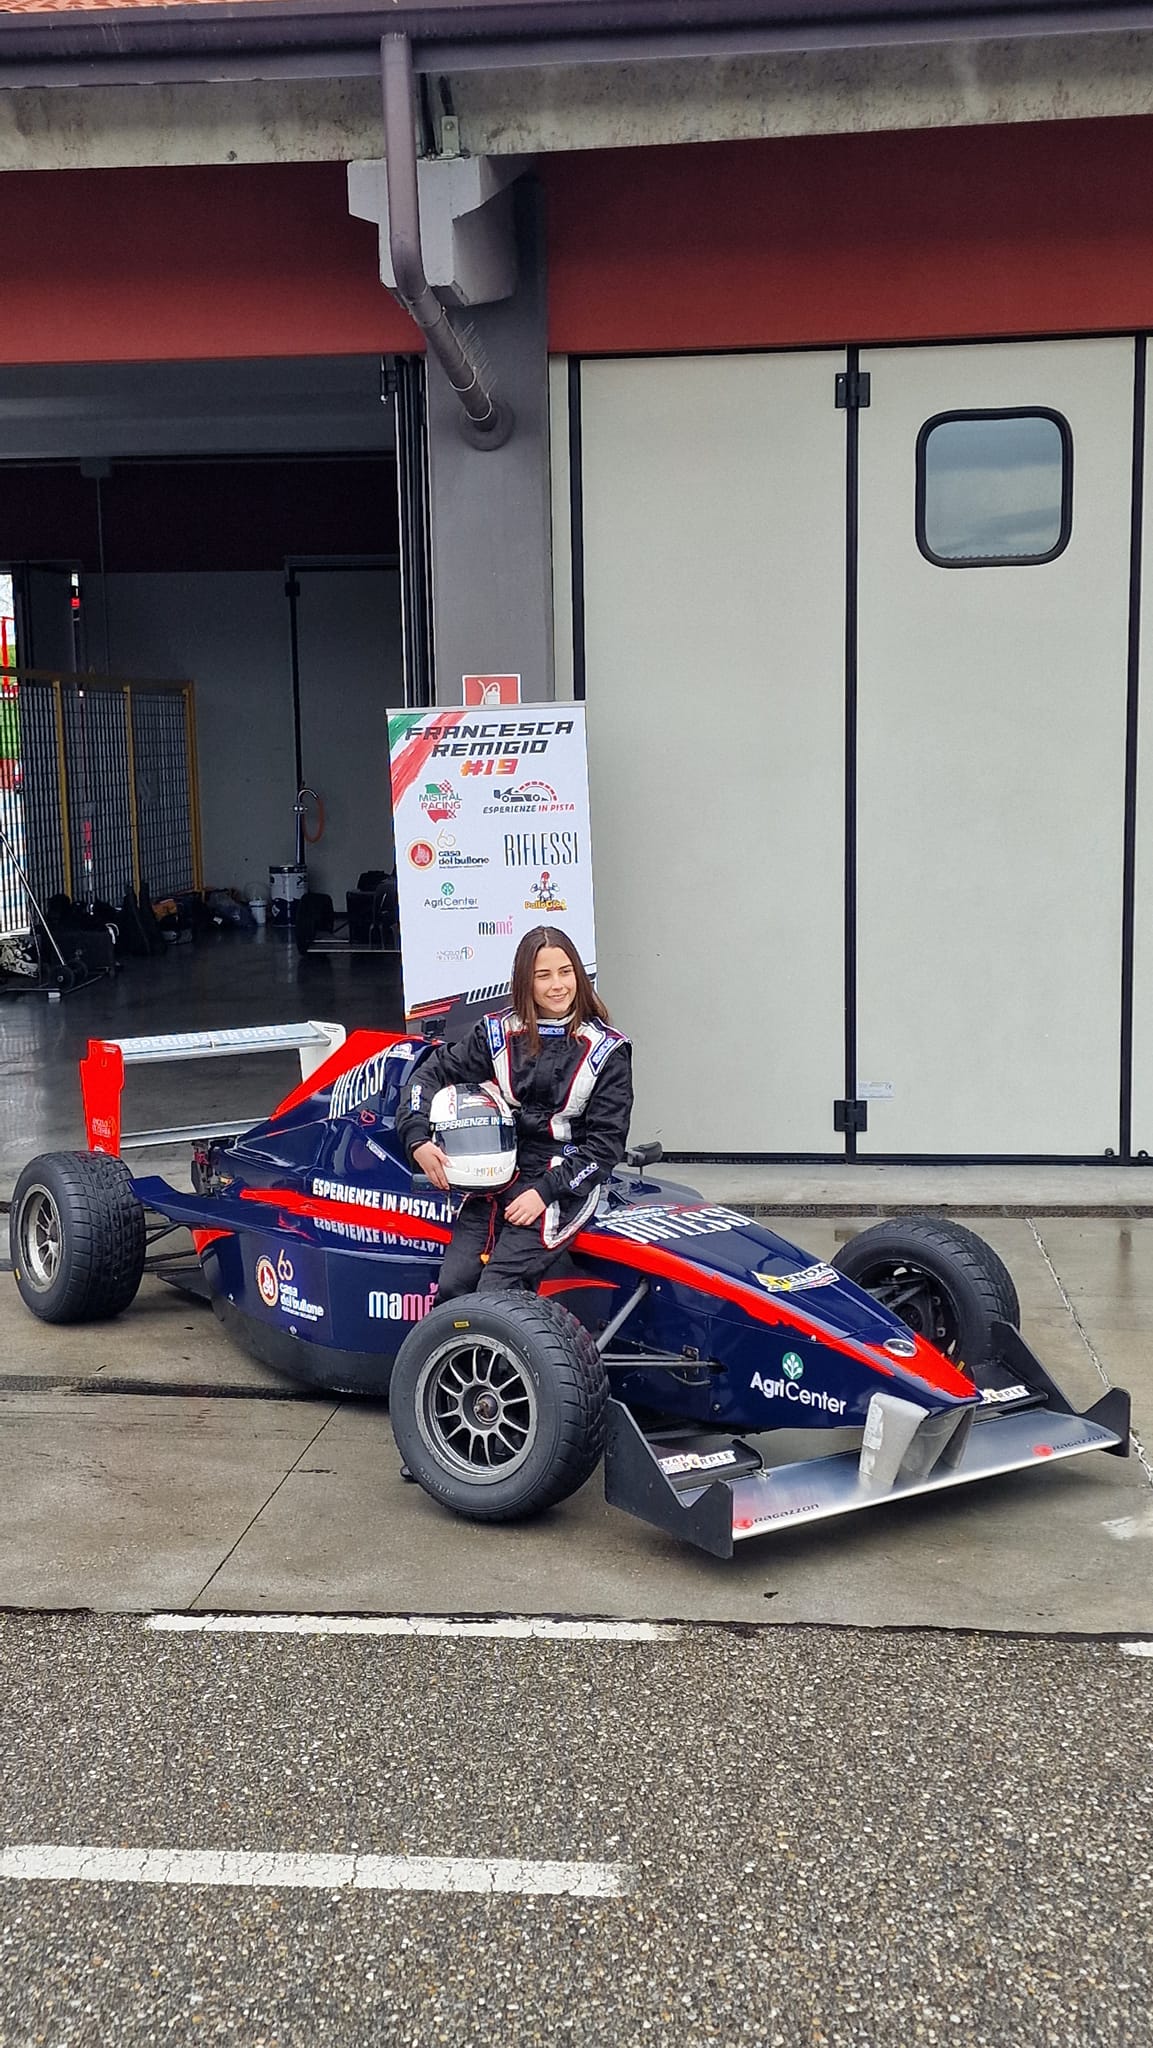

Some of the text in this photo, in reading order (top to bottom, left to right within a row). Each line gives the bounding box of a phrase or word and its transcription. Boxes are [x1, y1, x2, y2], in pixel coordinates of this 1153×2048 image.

[405, 721, 574, 740] FRANCESCA
[431, 740, 548, 757] REMIGIO
[461, 758, 518, 776] #19
[419, 793, 462, 801] MISTRAL
[421, 801, 461, 810] RACING
[483, 803, 575, 814] ESPERIENZE IN PISTA
[504, 832, 578, 866] RIFLESSI
[119, 1027, 287, 1050] ESPERIENZE IN PISTA
[435, 1116, 489, 1131] ESPERIENZE
[490, 1116, 500, 1126] IN
[312, 1178, 454, 1223] ESPERIENZE IN PISTA.IT
[605, 1206, 759, 1245] RIFLESSI
[750, 1371, 847, 1415] AgriCenter
